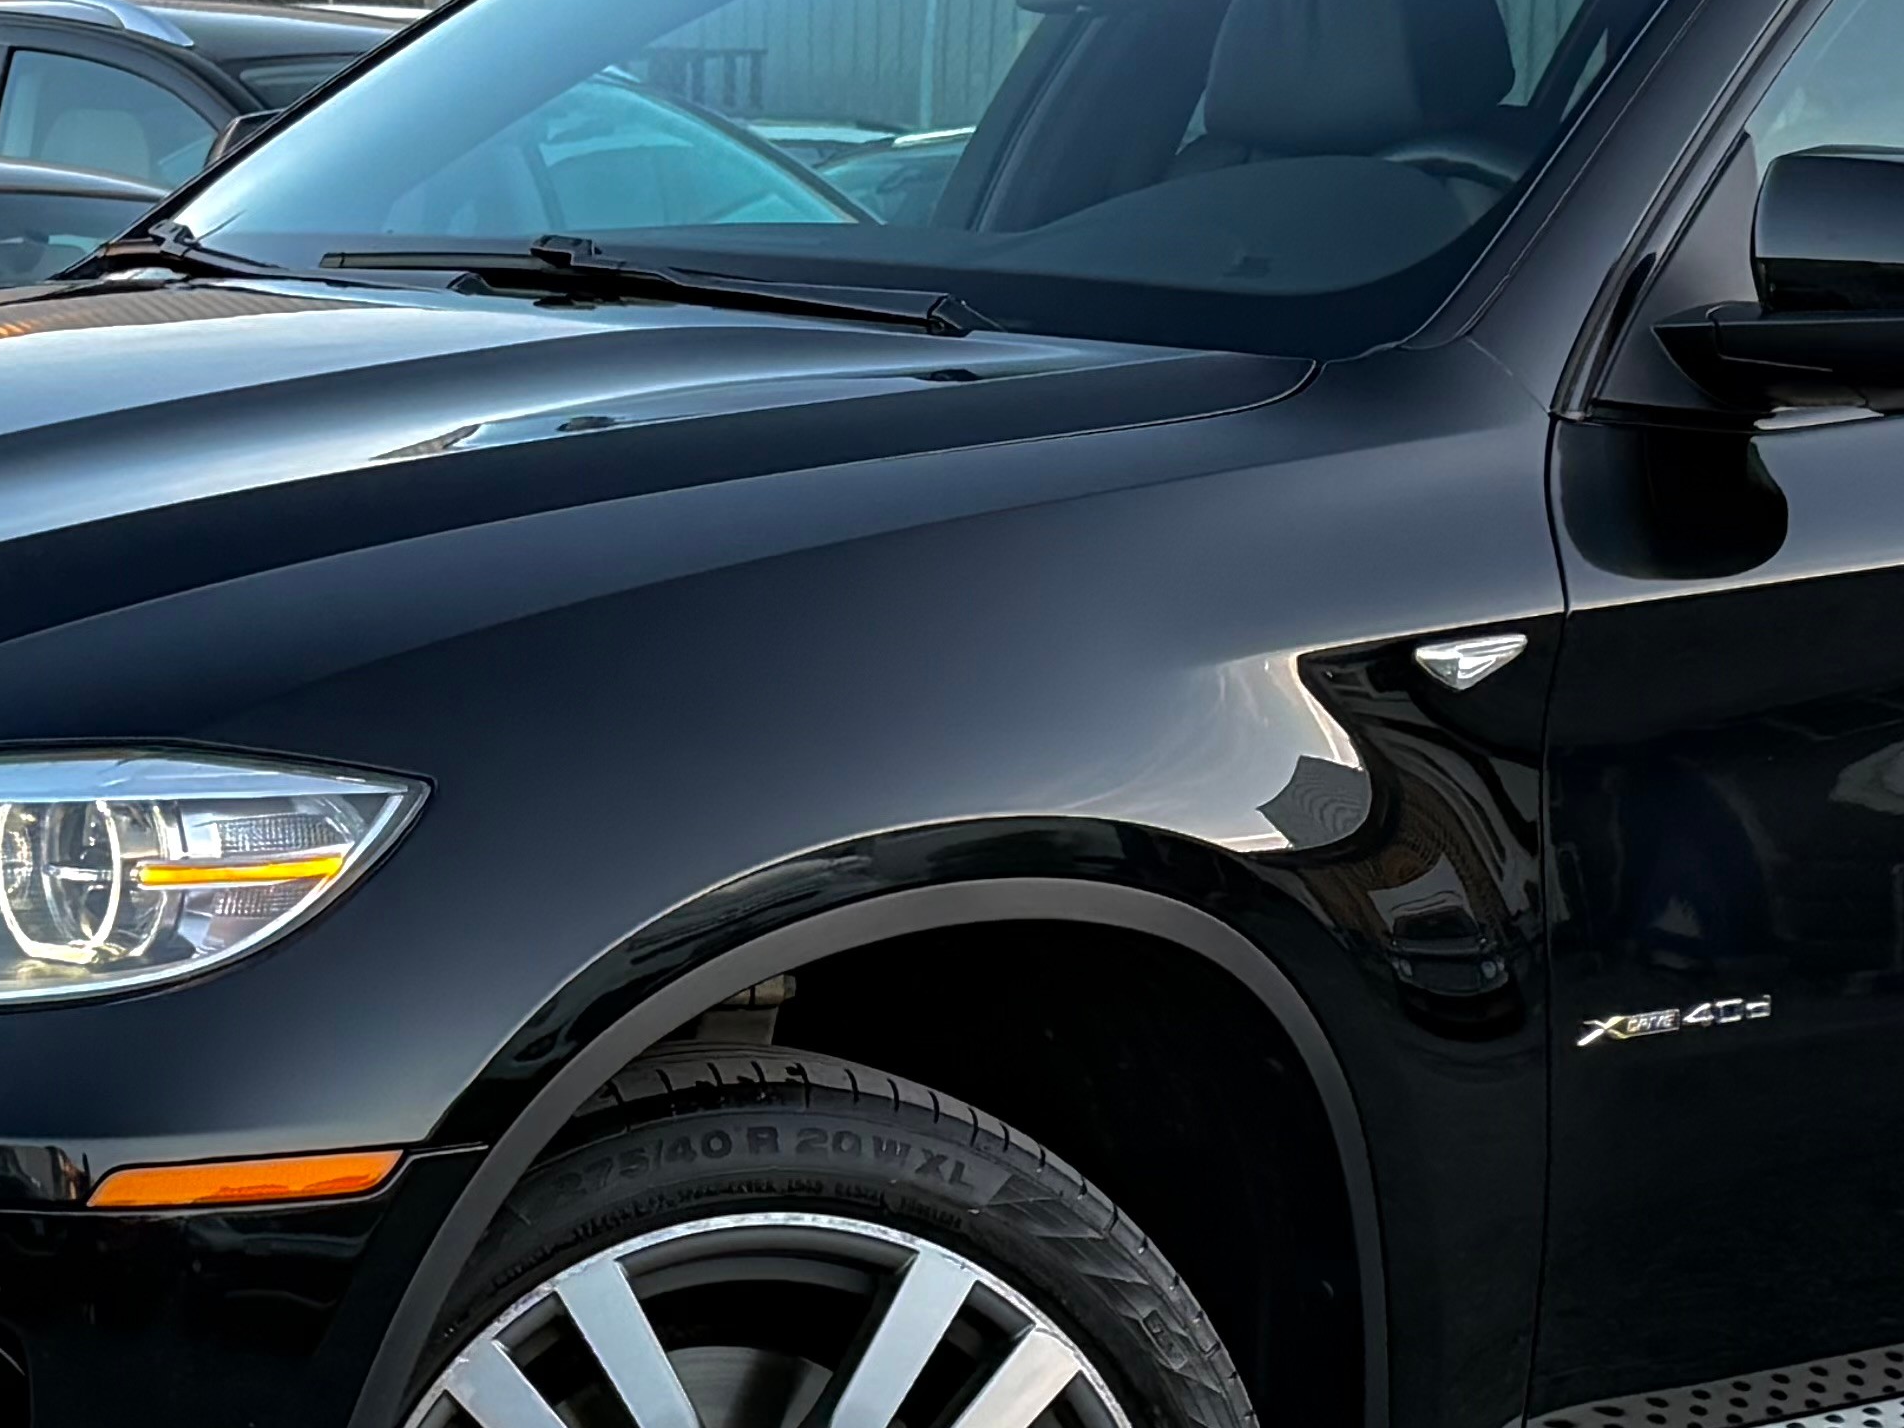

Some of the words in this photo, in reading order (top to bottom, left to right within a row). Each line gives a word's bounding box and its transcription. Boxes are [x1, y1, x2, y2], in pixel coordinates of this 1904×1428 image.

[556, 1128, 734, 1195] 275/40
[746, 1125, 781, 1155] R
[795, 1126, 863, 1157] 20
[871, 1134, 912, 1168] W
[914, 1147, 974, 1191] XL
